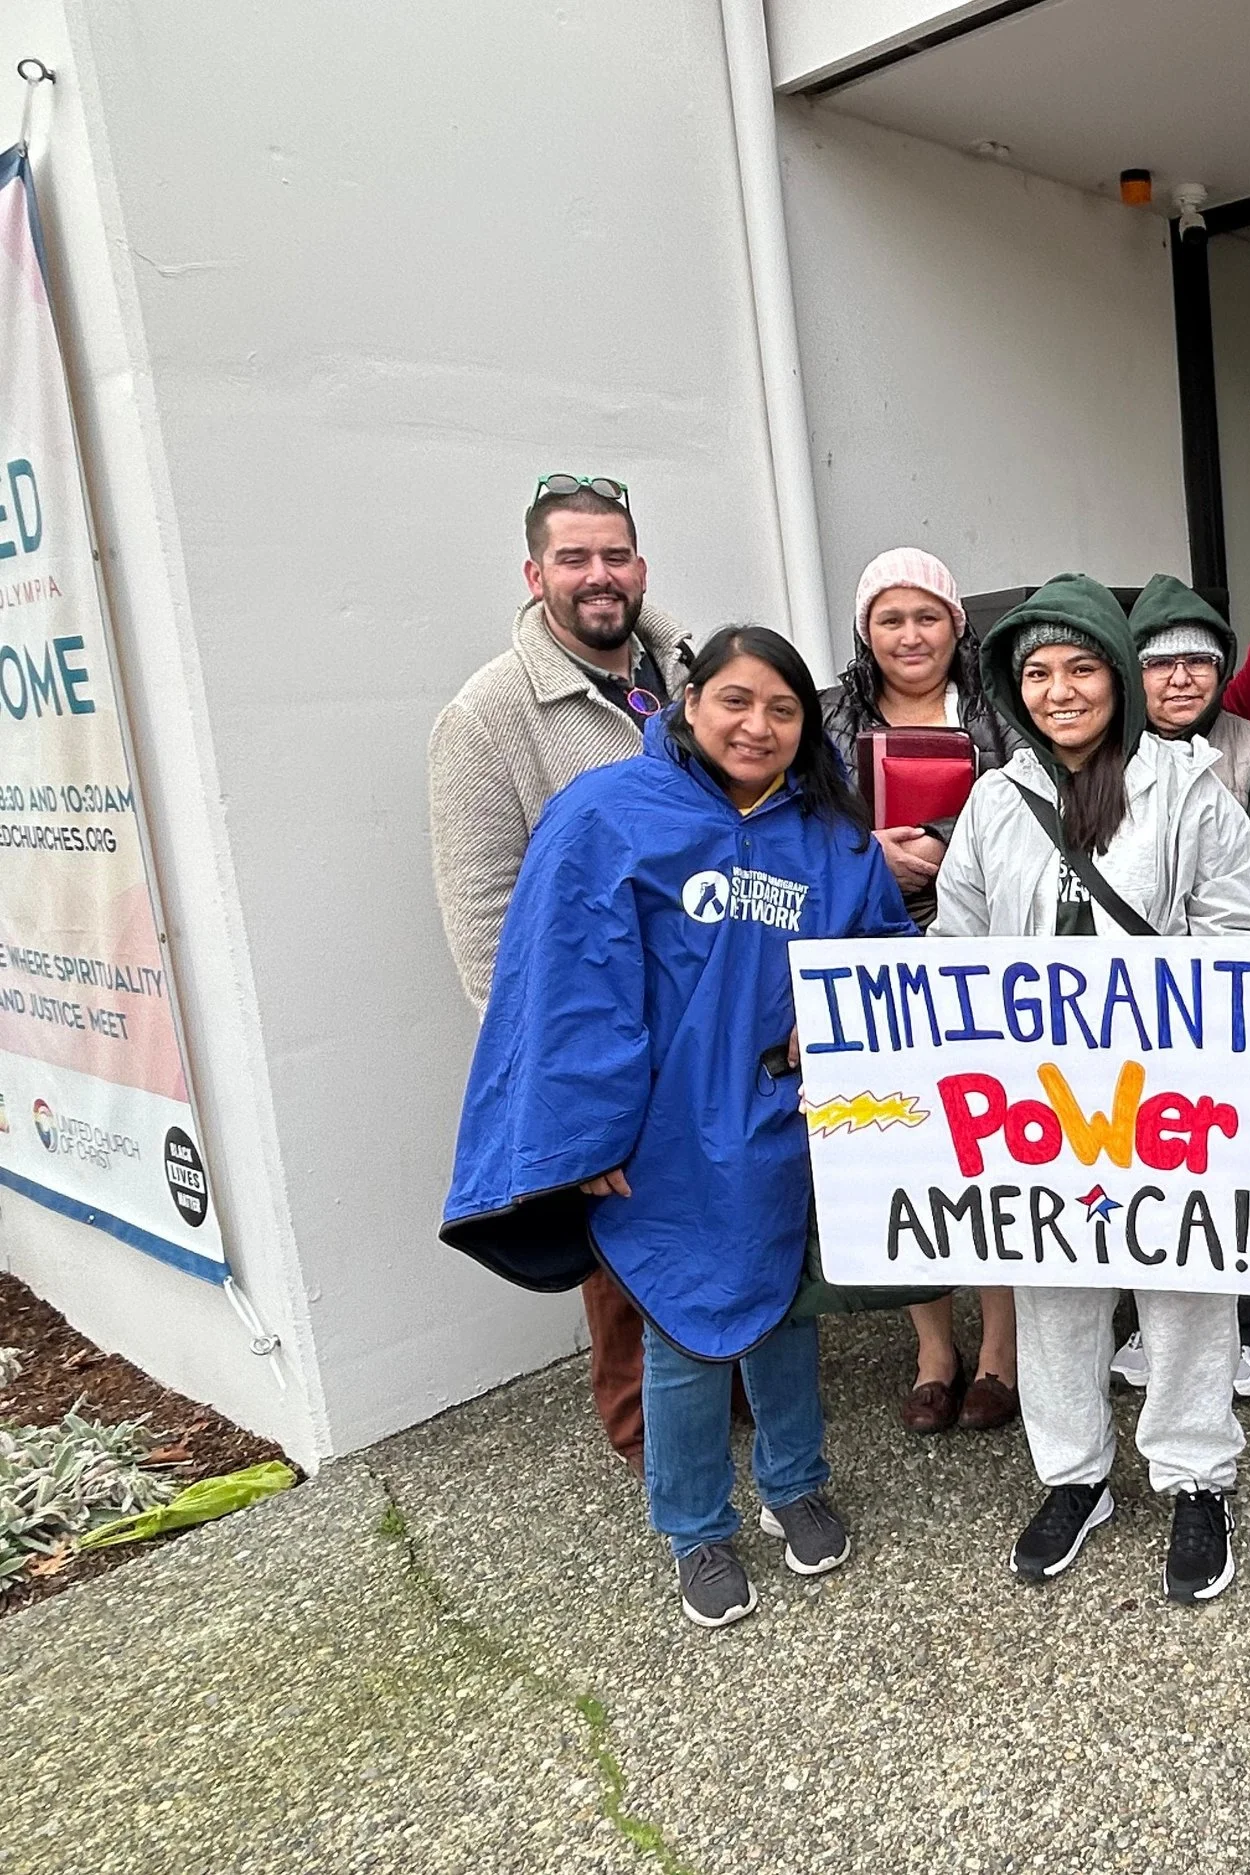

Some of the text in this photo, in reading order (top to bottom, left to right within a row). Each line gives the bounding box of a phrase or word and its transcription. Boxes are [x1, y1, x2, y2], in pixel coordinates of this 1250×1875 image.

[30, 785, 57, 812] AND
[60, 784, 136, 813] 10:30AM
[7, 945, 53, 979] WHERE
[54, 954, 161, 998] SPIRITUALITY
[30, 993, 86, 1030] JUSTICE
[87, 1007, 128, 1040] MEET
[170, 1165, 200, 1189] LIVES
